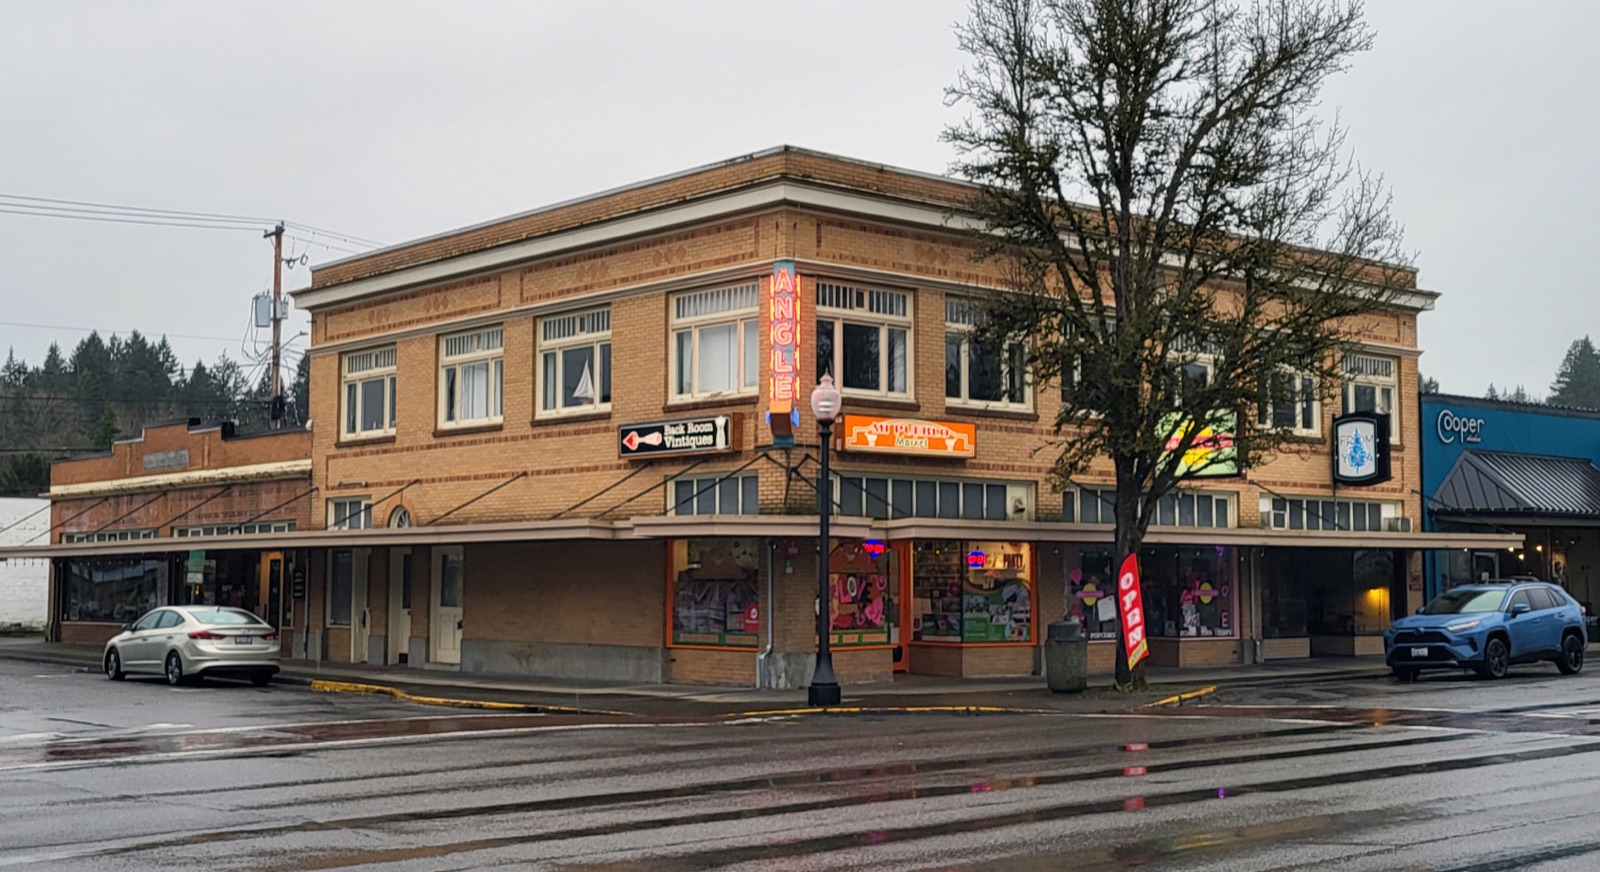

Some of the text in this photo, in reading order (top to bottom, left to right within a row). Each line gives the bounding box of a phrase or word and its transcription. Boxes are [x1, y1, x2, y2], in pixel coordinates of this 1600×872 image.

[774, 268, 794, 399] ANGLE
[664, 422, 714, 435] Back Room
[871, 421, 951, 438] MI PUEBLO
[1437, 409, 1485, 444] Cooper
[663, 434, 714, 449] Vintiques
[895, 437, 928, 448] Market
[966, 554, 987, 565] OPEN
[837, 575, 873, 604] LOVE
[1120, 571, 1144, 648] OPEN
